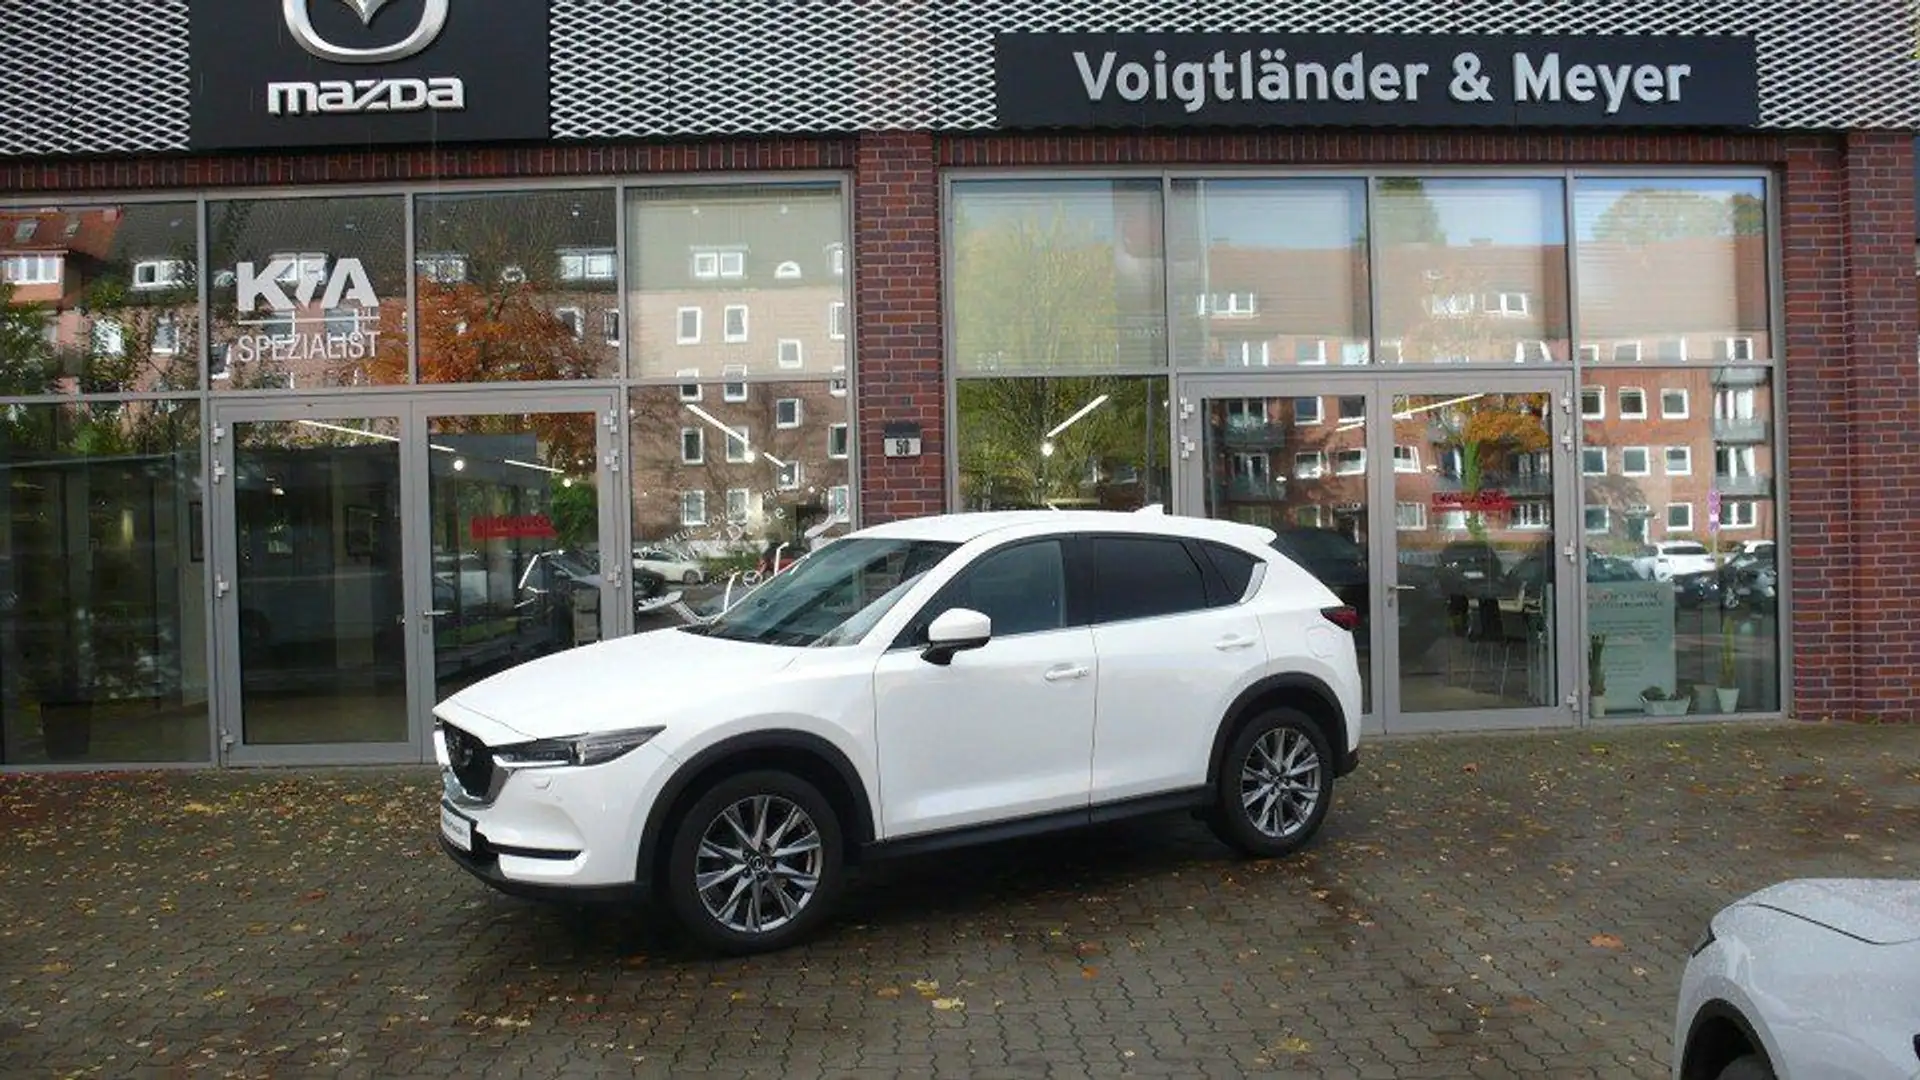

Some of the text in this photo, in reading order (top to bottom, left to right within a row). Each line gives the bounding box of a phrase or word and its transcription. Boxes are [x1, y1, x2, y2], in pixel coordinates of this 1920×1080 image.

[1072, 48, 1692, 114] Voigtländer & Meyer
[236, 257, 380, 312] KIA
[237, 331, 381, 362] SPEZIALIST
